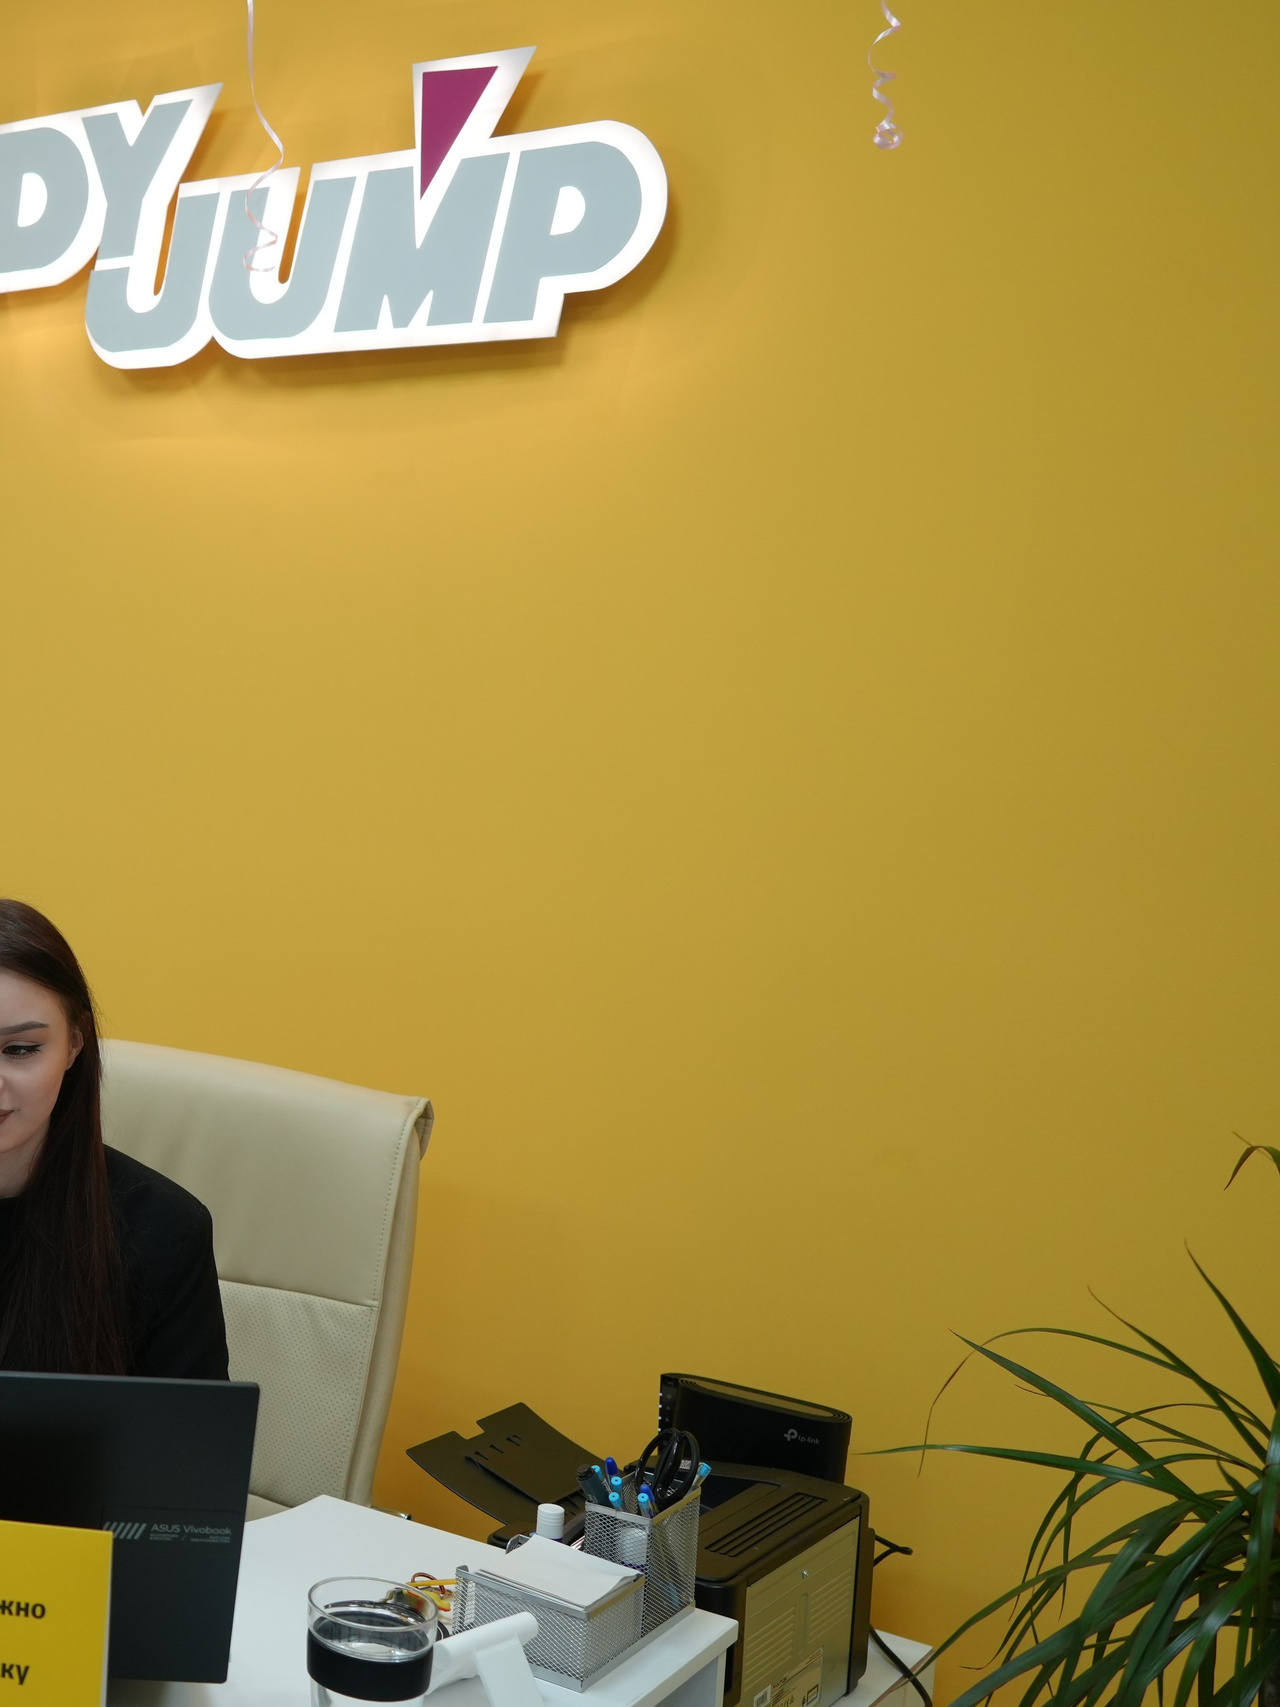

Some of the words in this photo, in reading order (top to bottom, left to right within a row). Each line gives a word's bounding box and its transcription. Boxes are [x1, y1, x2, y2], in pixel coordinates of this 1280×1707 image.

[88, 62, 644, 353] JUMP
[150, 1523, 180, 1533] ASUS
[183, 1525, 232, 1535] Vivobook
